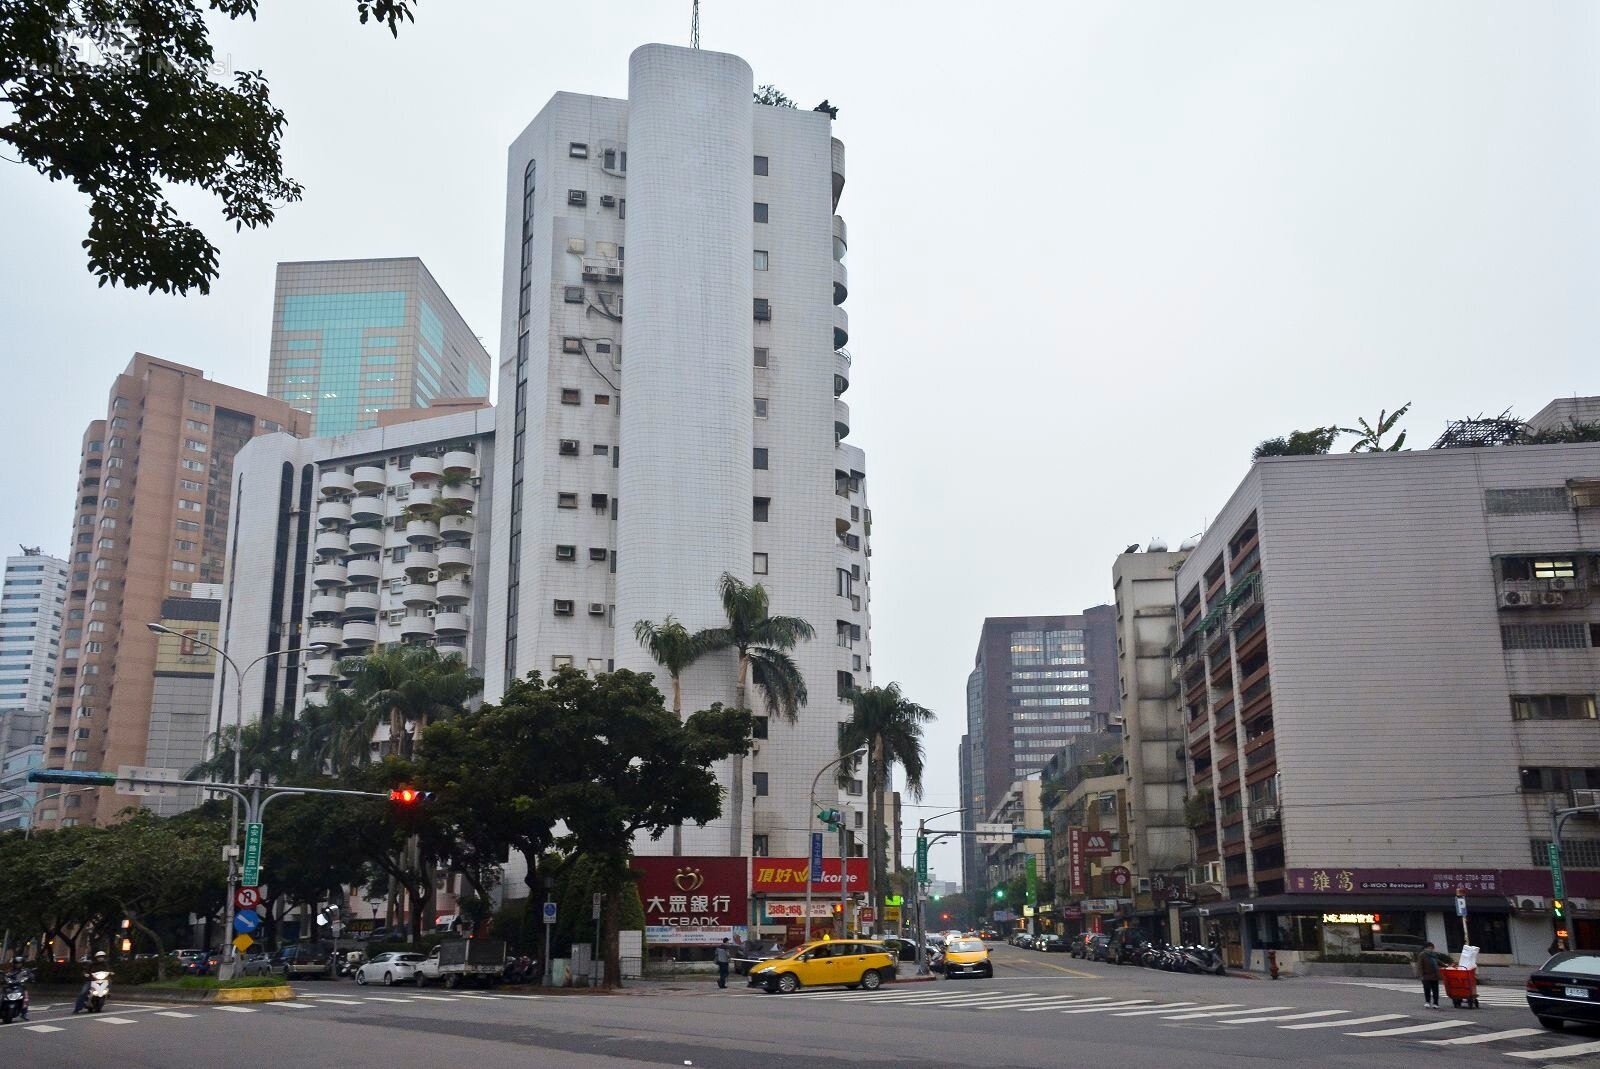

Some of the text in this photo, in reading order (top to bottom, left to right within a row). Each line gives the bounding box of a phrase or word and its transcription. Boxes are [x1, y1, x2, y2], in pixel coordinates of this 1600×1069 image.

[757, 866, 857, 883] 頂好 Wlcoe
[647, 895, 731, 913] 大眾銀行
[658, 917, 720, 926] TCBANK
